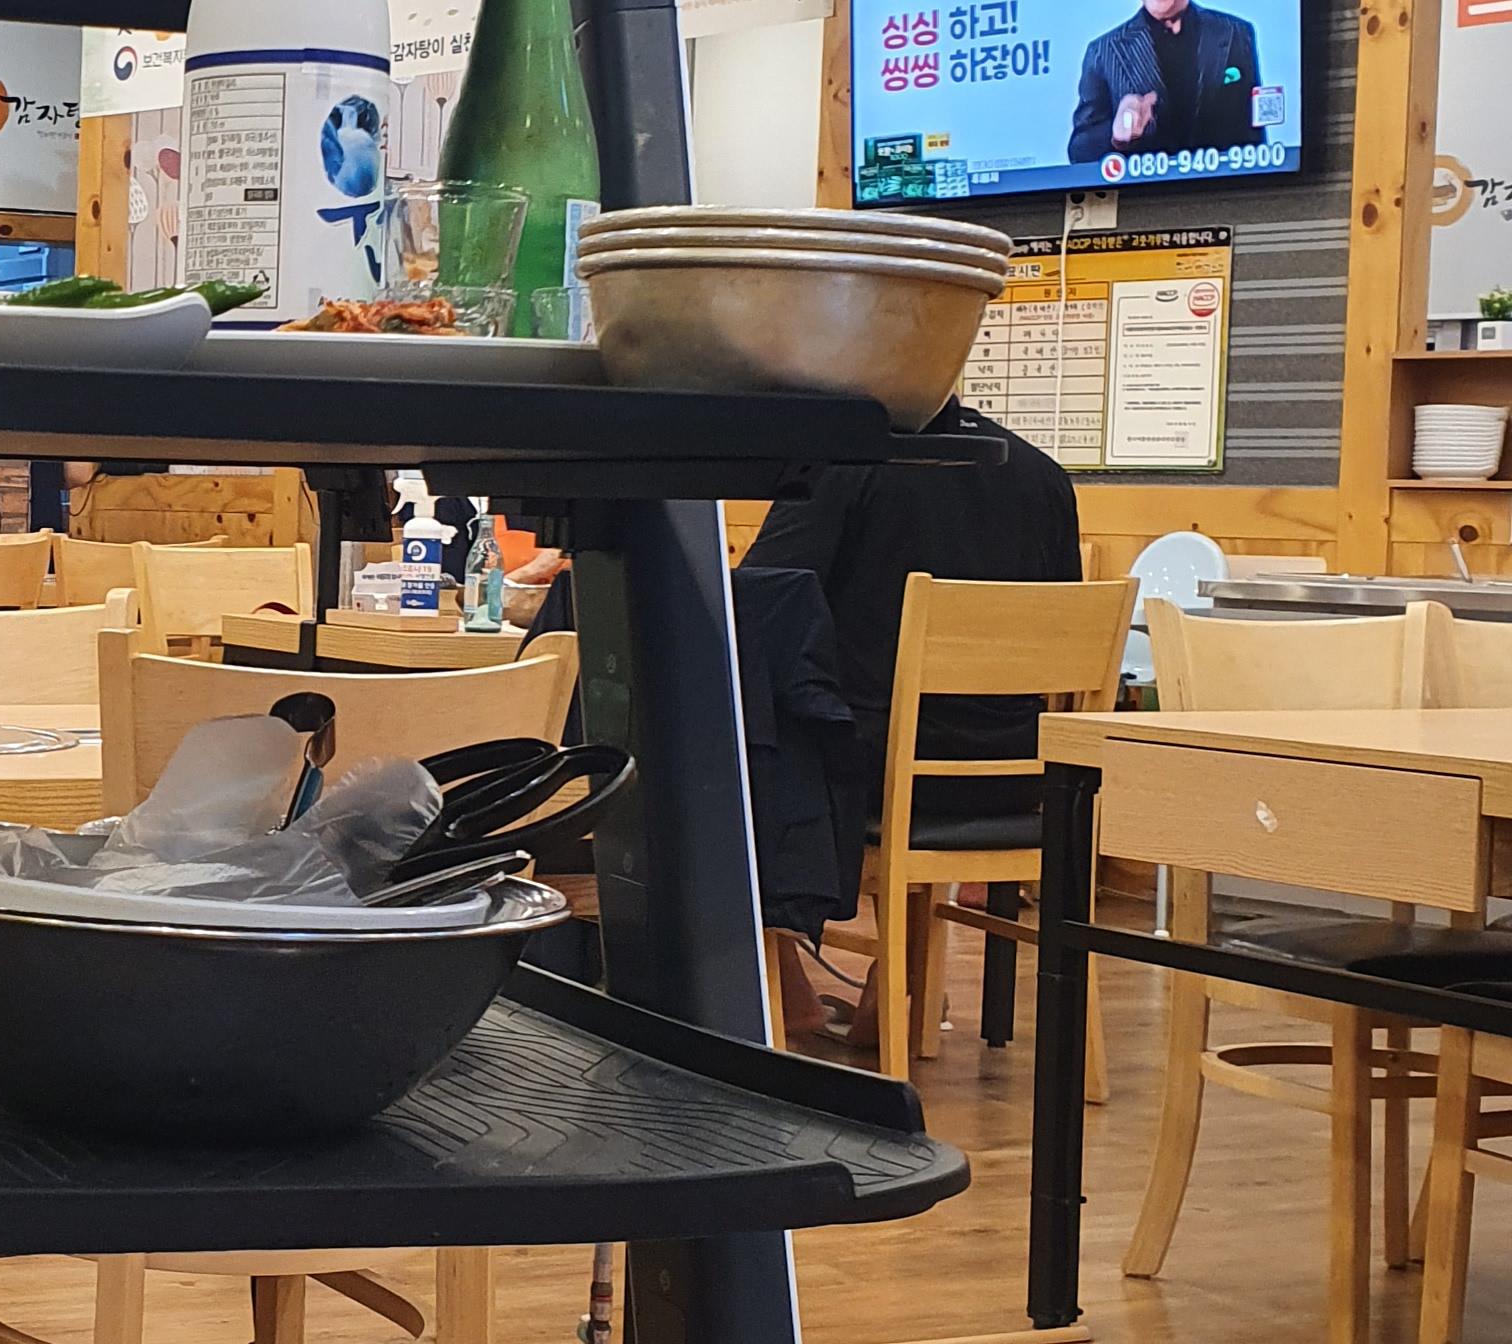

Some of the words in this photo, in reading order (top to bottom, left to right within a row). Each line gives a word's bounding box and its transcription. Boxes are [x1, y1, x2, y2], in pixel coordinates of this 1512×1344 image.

[881, 9, 941, 50] 싱싱
[949, 0, 1019, 40] 하고!
[143, 48, 187, 69] 보건복지
[390, 37, 445, 62] 감자탕이
[881, 52, 941, 93] 씽씽
[949, 40, 1051, 84] 하잖아!
[1128, 142, 1287, 178] 080-940-9900
